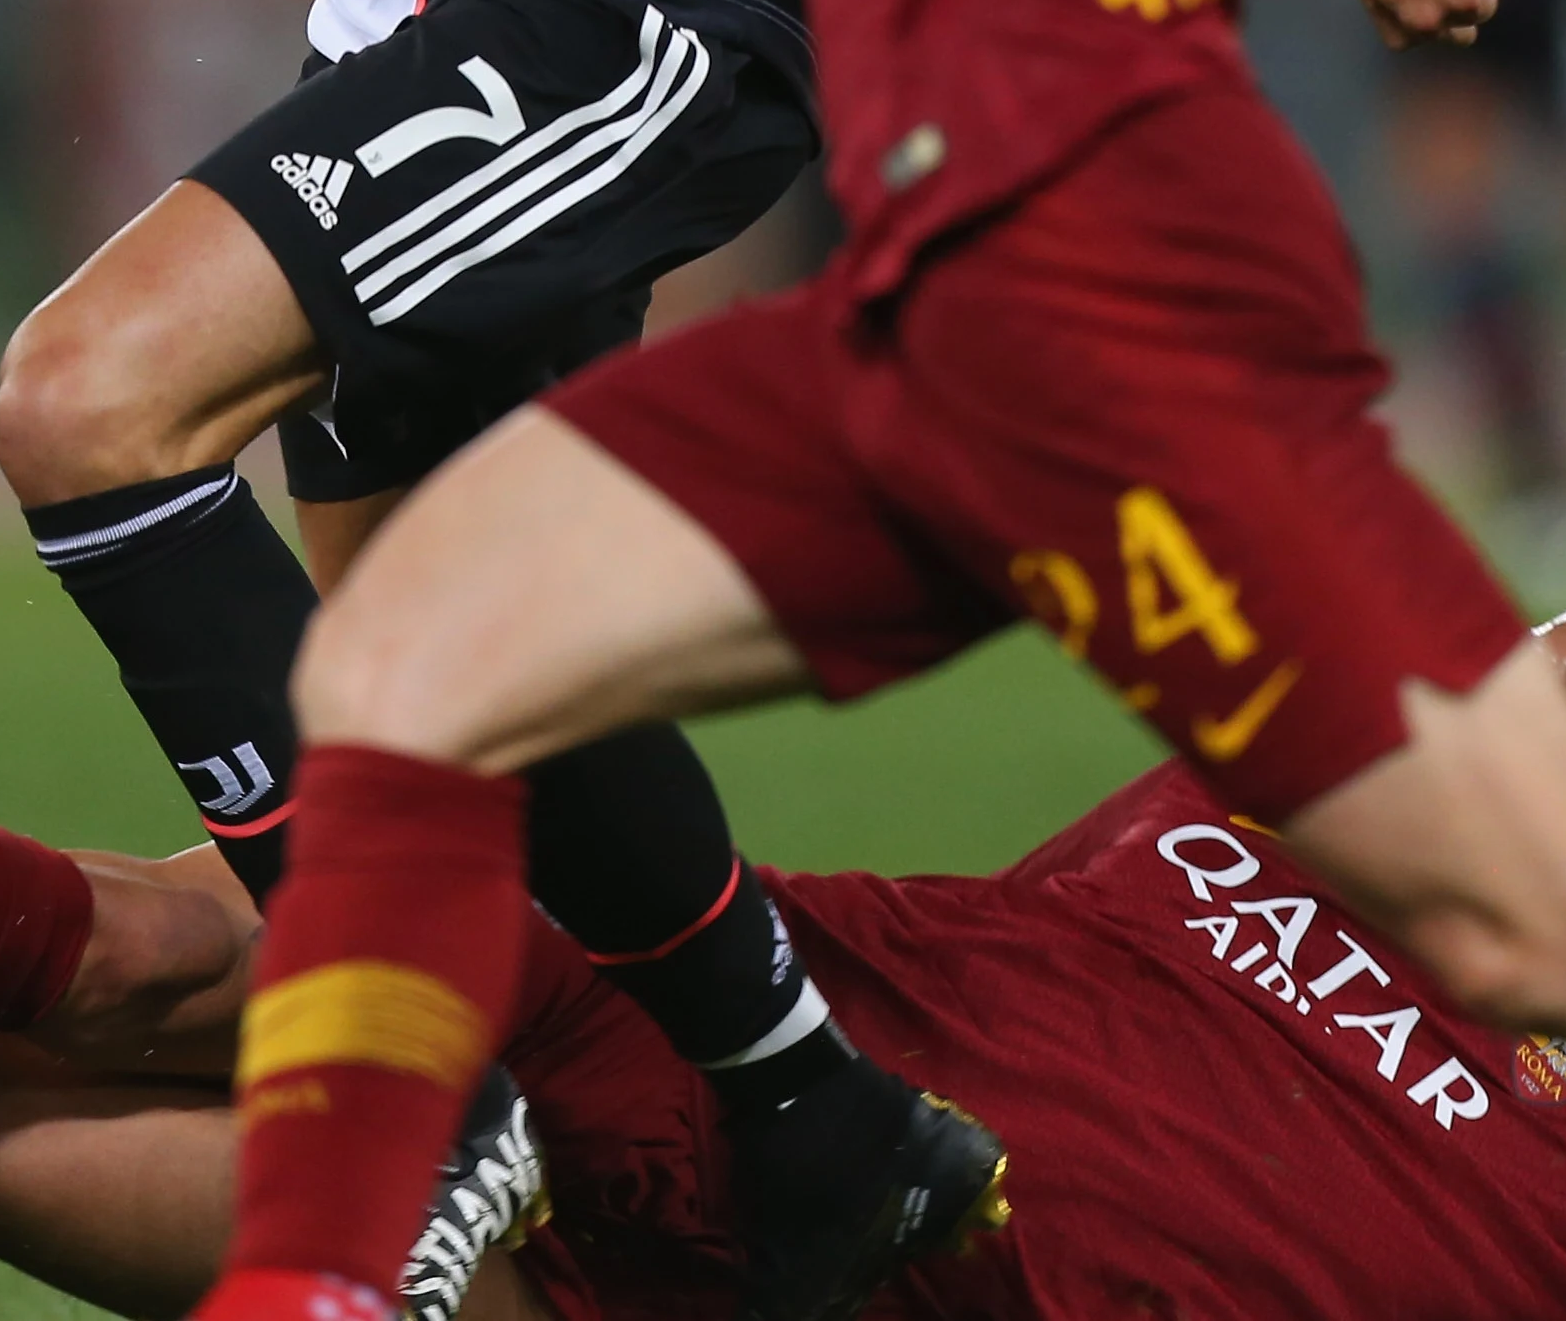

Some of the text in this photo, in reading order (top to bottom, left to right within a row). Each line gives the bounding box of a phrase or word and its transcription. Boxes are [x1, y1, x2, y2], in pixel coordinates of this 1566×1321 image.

[354, 55, 527, 179] 7
[270, 154, 338, 231] adidas
[1156, 823, 1490, 1131] QATAR
[1516, 1044, 1562, 1102] ROMA
